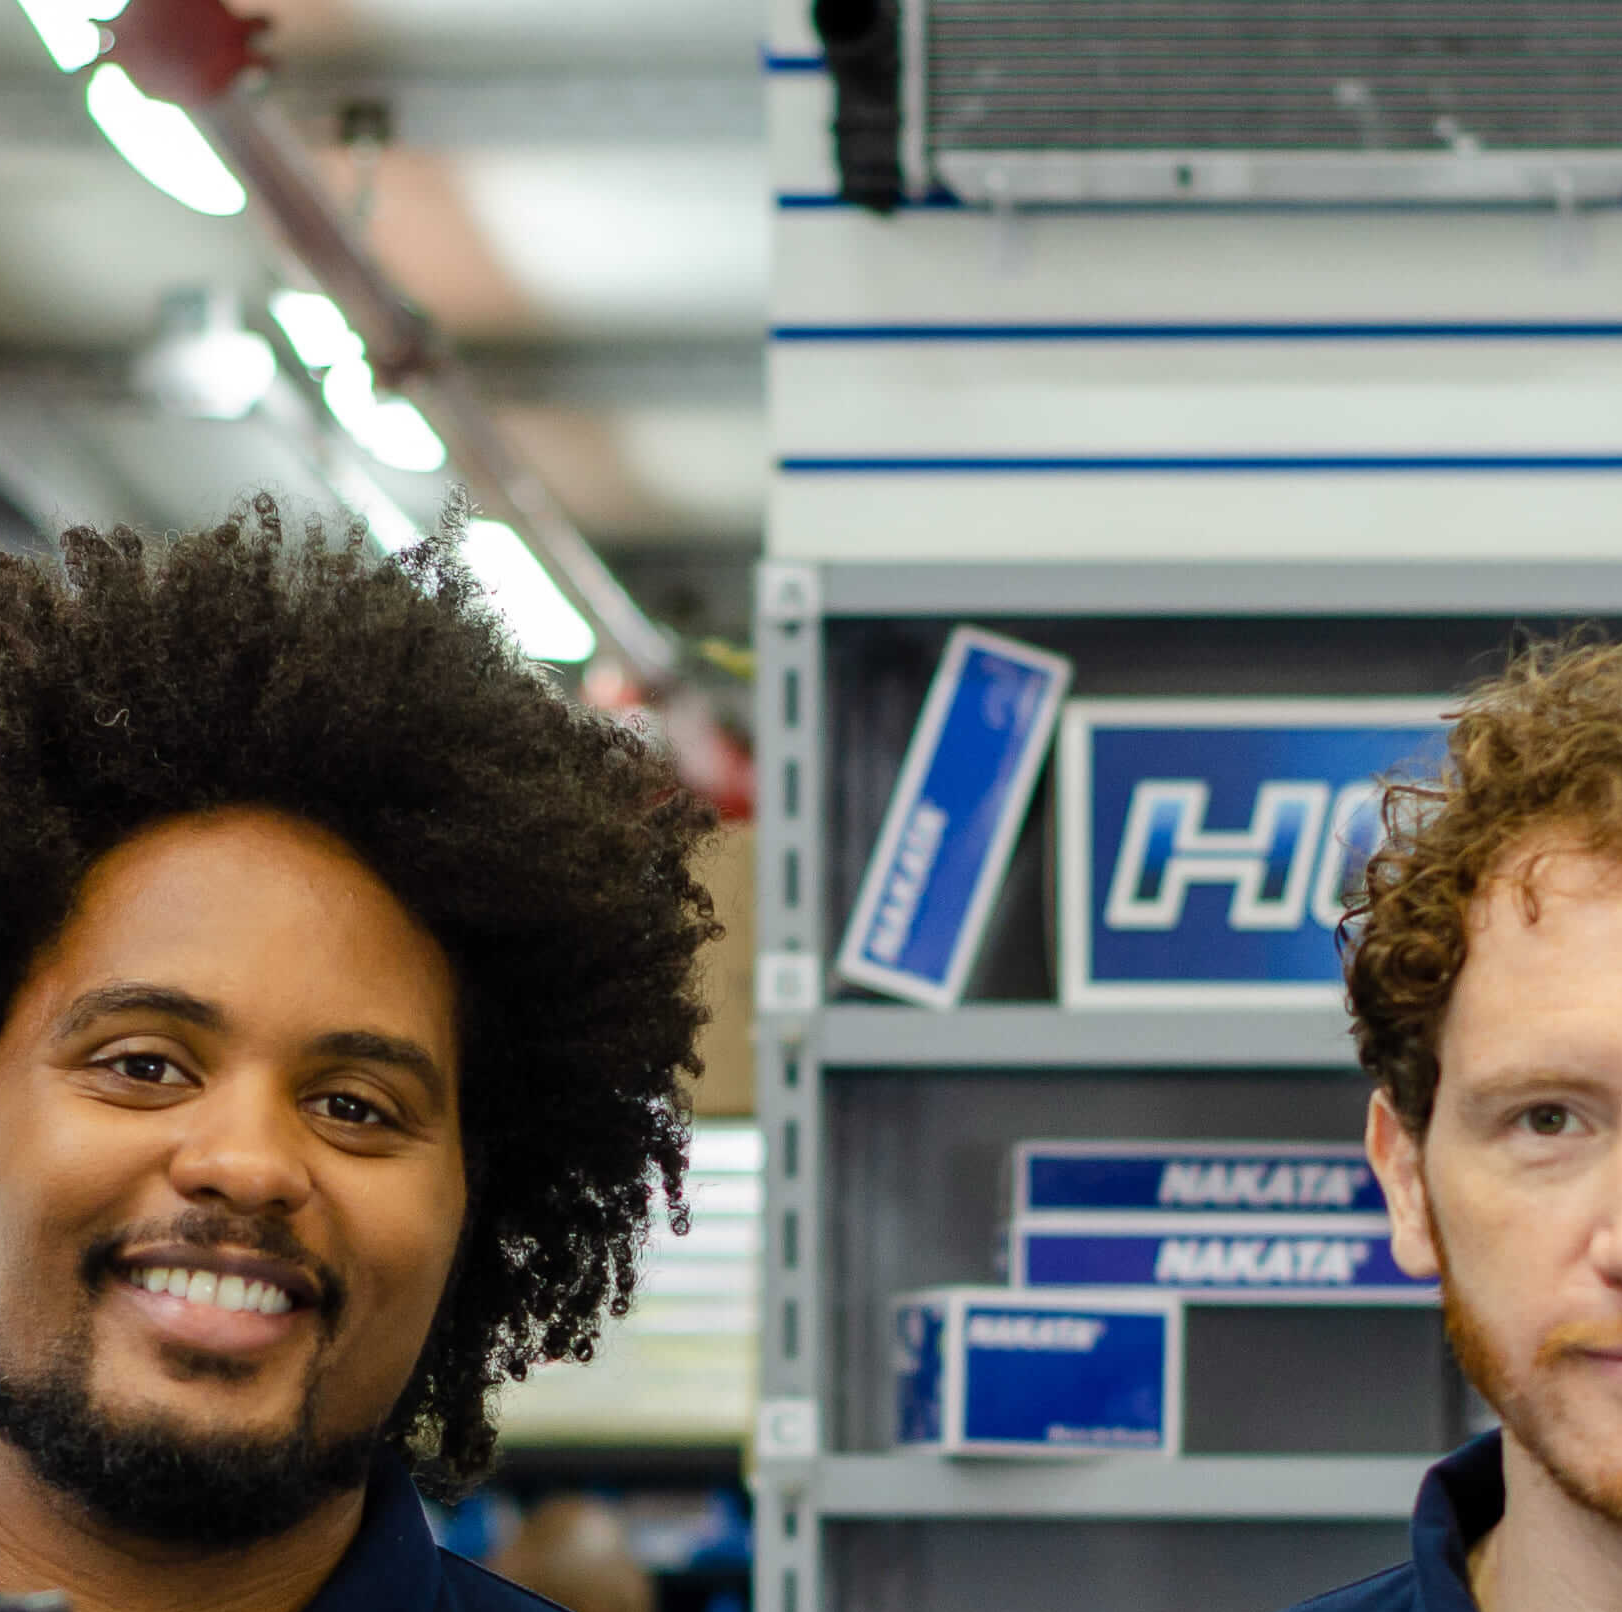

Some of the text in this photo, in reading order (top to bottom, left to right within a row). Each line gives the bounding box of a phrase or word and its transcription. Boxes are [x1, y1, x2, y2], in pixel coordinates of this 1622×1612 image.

[869, 802, 949, 963] NAKATA
[1159, 1163, 1353, 1205] NAKATA
[1155, 1240, 1353, 1282] NAKATA
[968, 1315, 1099, 1351] NAKATA
